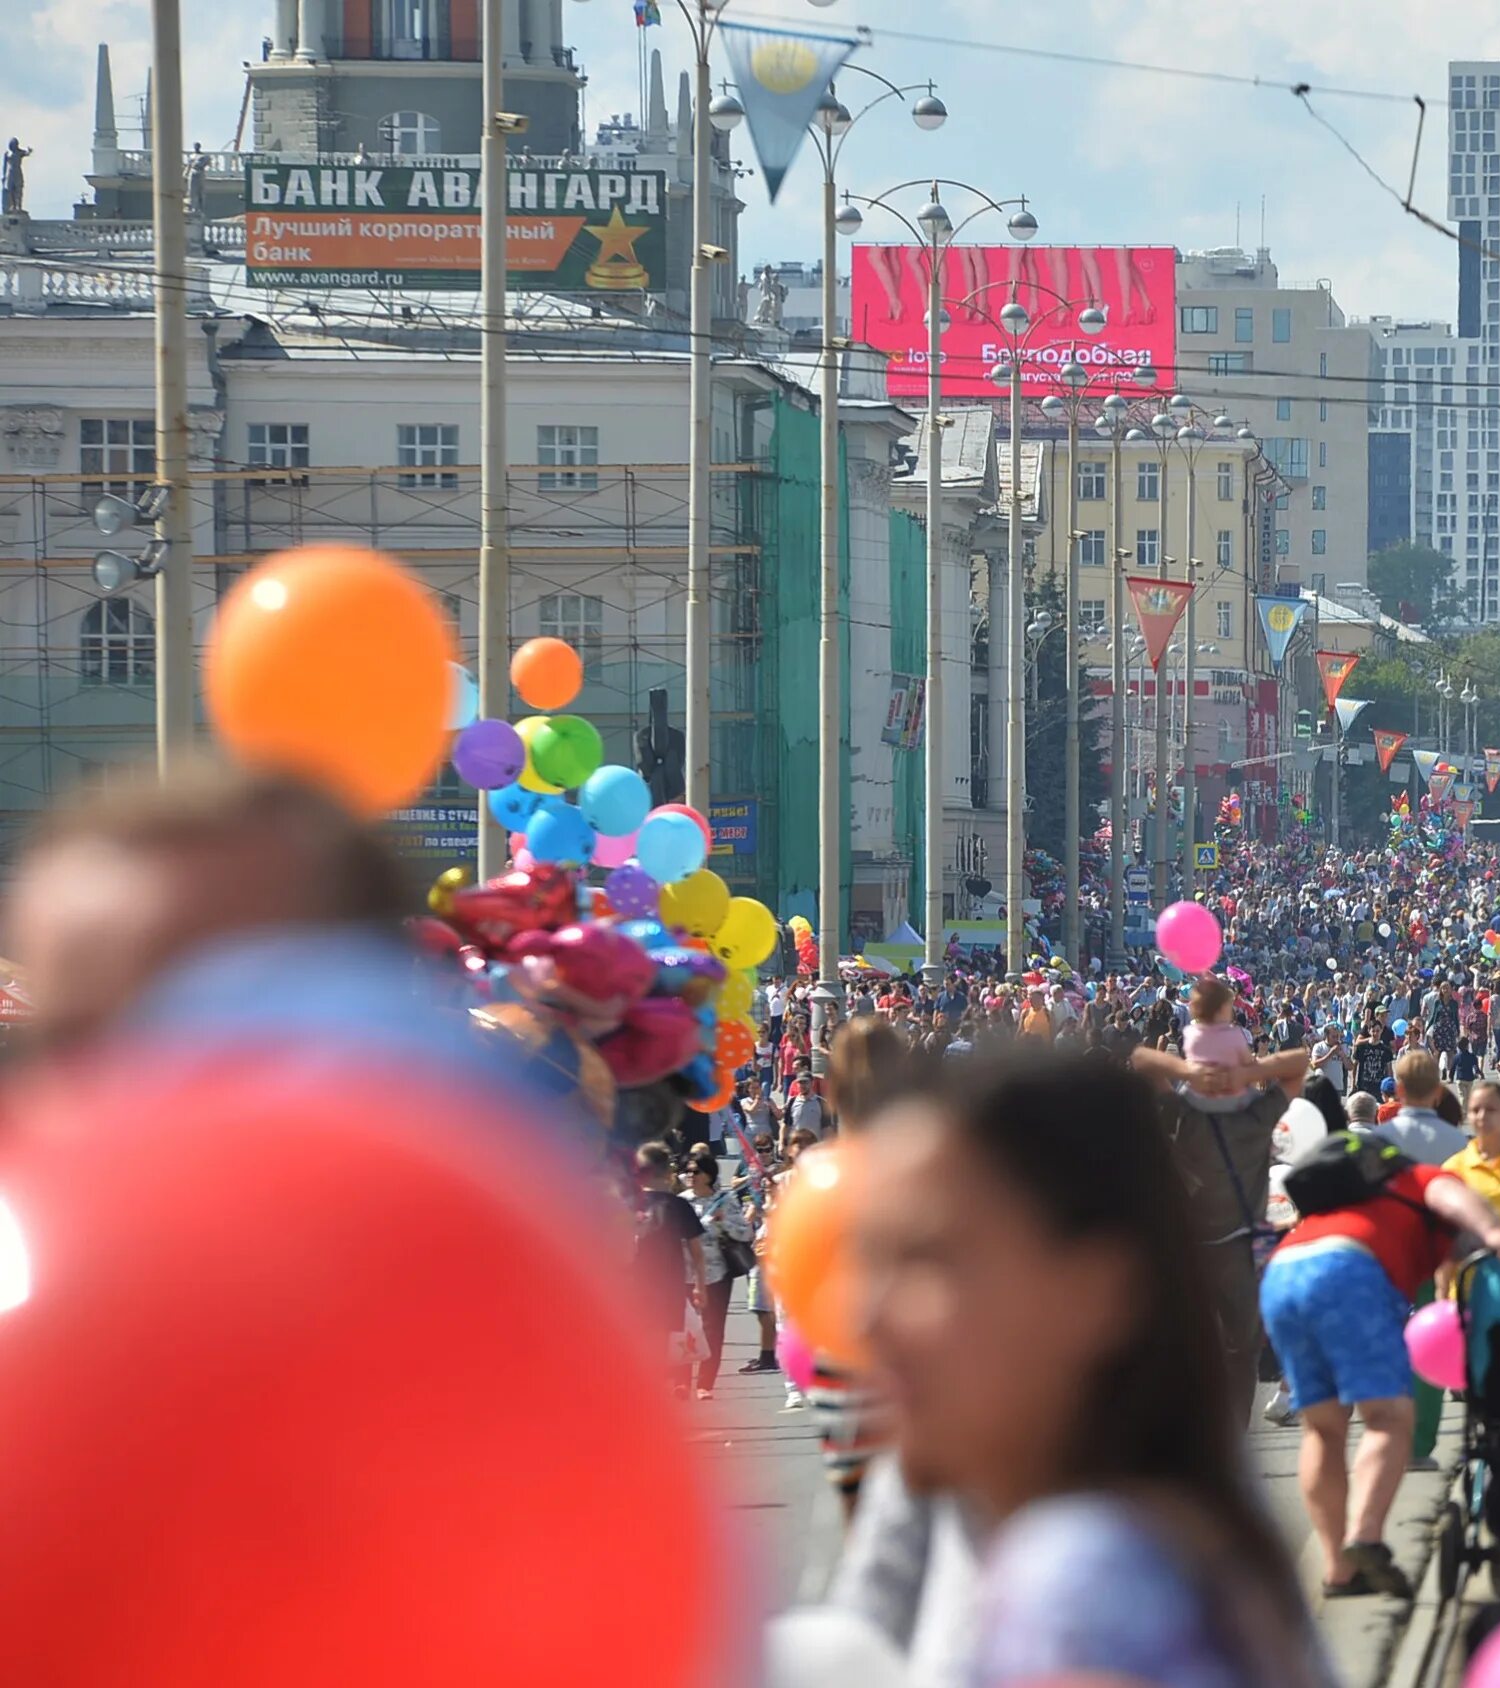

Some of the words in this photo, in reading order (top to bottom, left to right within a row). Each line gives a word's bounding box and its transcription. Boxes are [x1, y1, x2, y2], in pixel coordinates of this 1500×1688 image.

[251, 168, 385, 206] БАНК
[252, 217, 352, 239] Лучший
[359, 220, 555, 241] корпоратный
[253, 243, 312, 261] банк
[252, 270, 403, 287] www.avangard.ru
